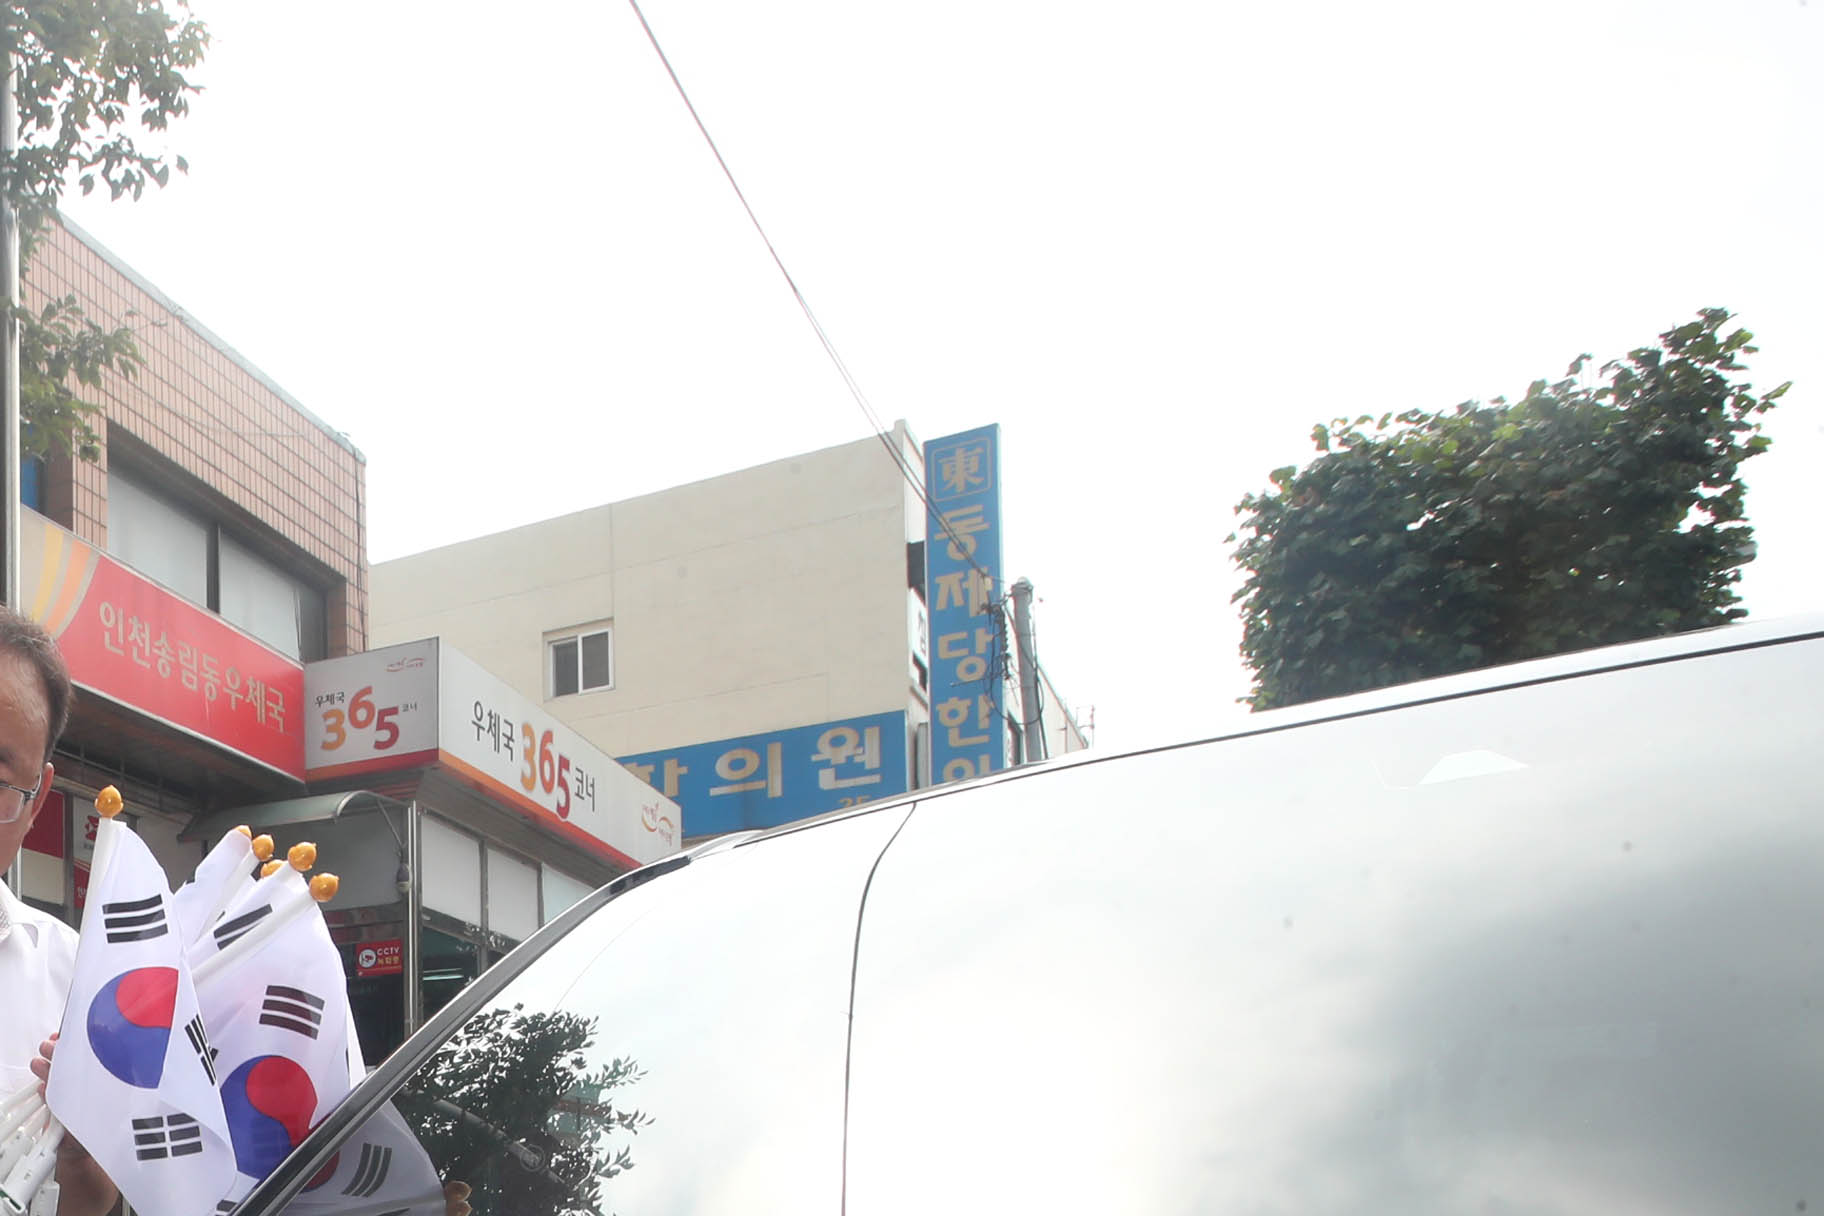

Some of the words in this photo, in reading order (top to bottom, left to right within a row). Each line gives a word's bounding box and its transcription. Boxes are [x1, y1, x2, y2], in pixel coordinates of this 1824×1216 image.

[937, 447, 985, 493] 東
[99, 601, 286, 733] 인천송림동우체국
[315, 691, 345, 707] 우체국
[320, 685, 399, 751] 365
[471, 700, 515, 762] 우체국
[520, 722, 571, 819] 365
[574, 766, 595, 812] 코너
[377, 947, 400, 956] CCTV
